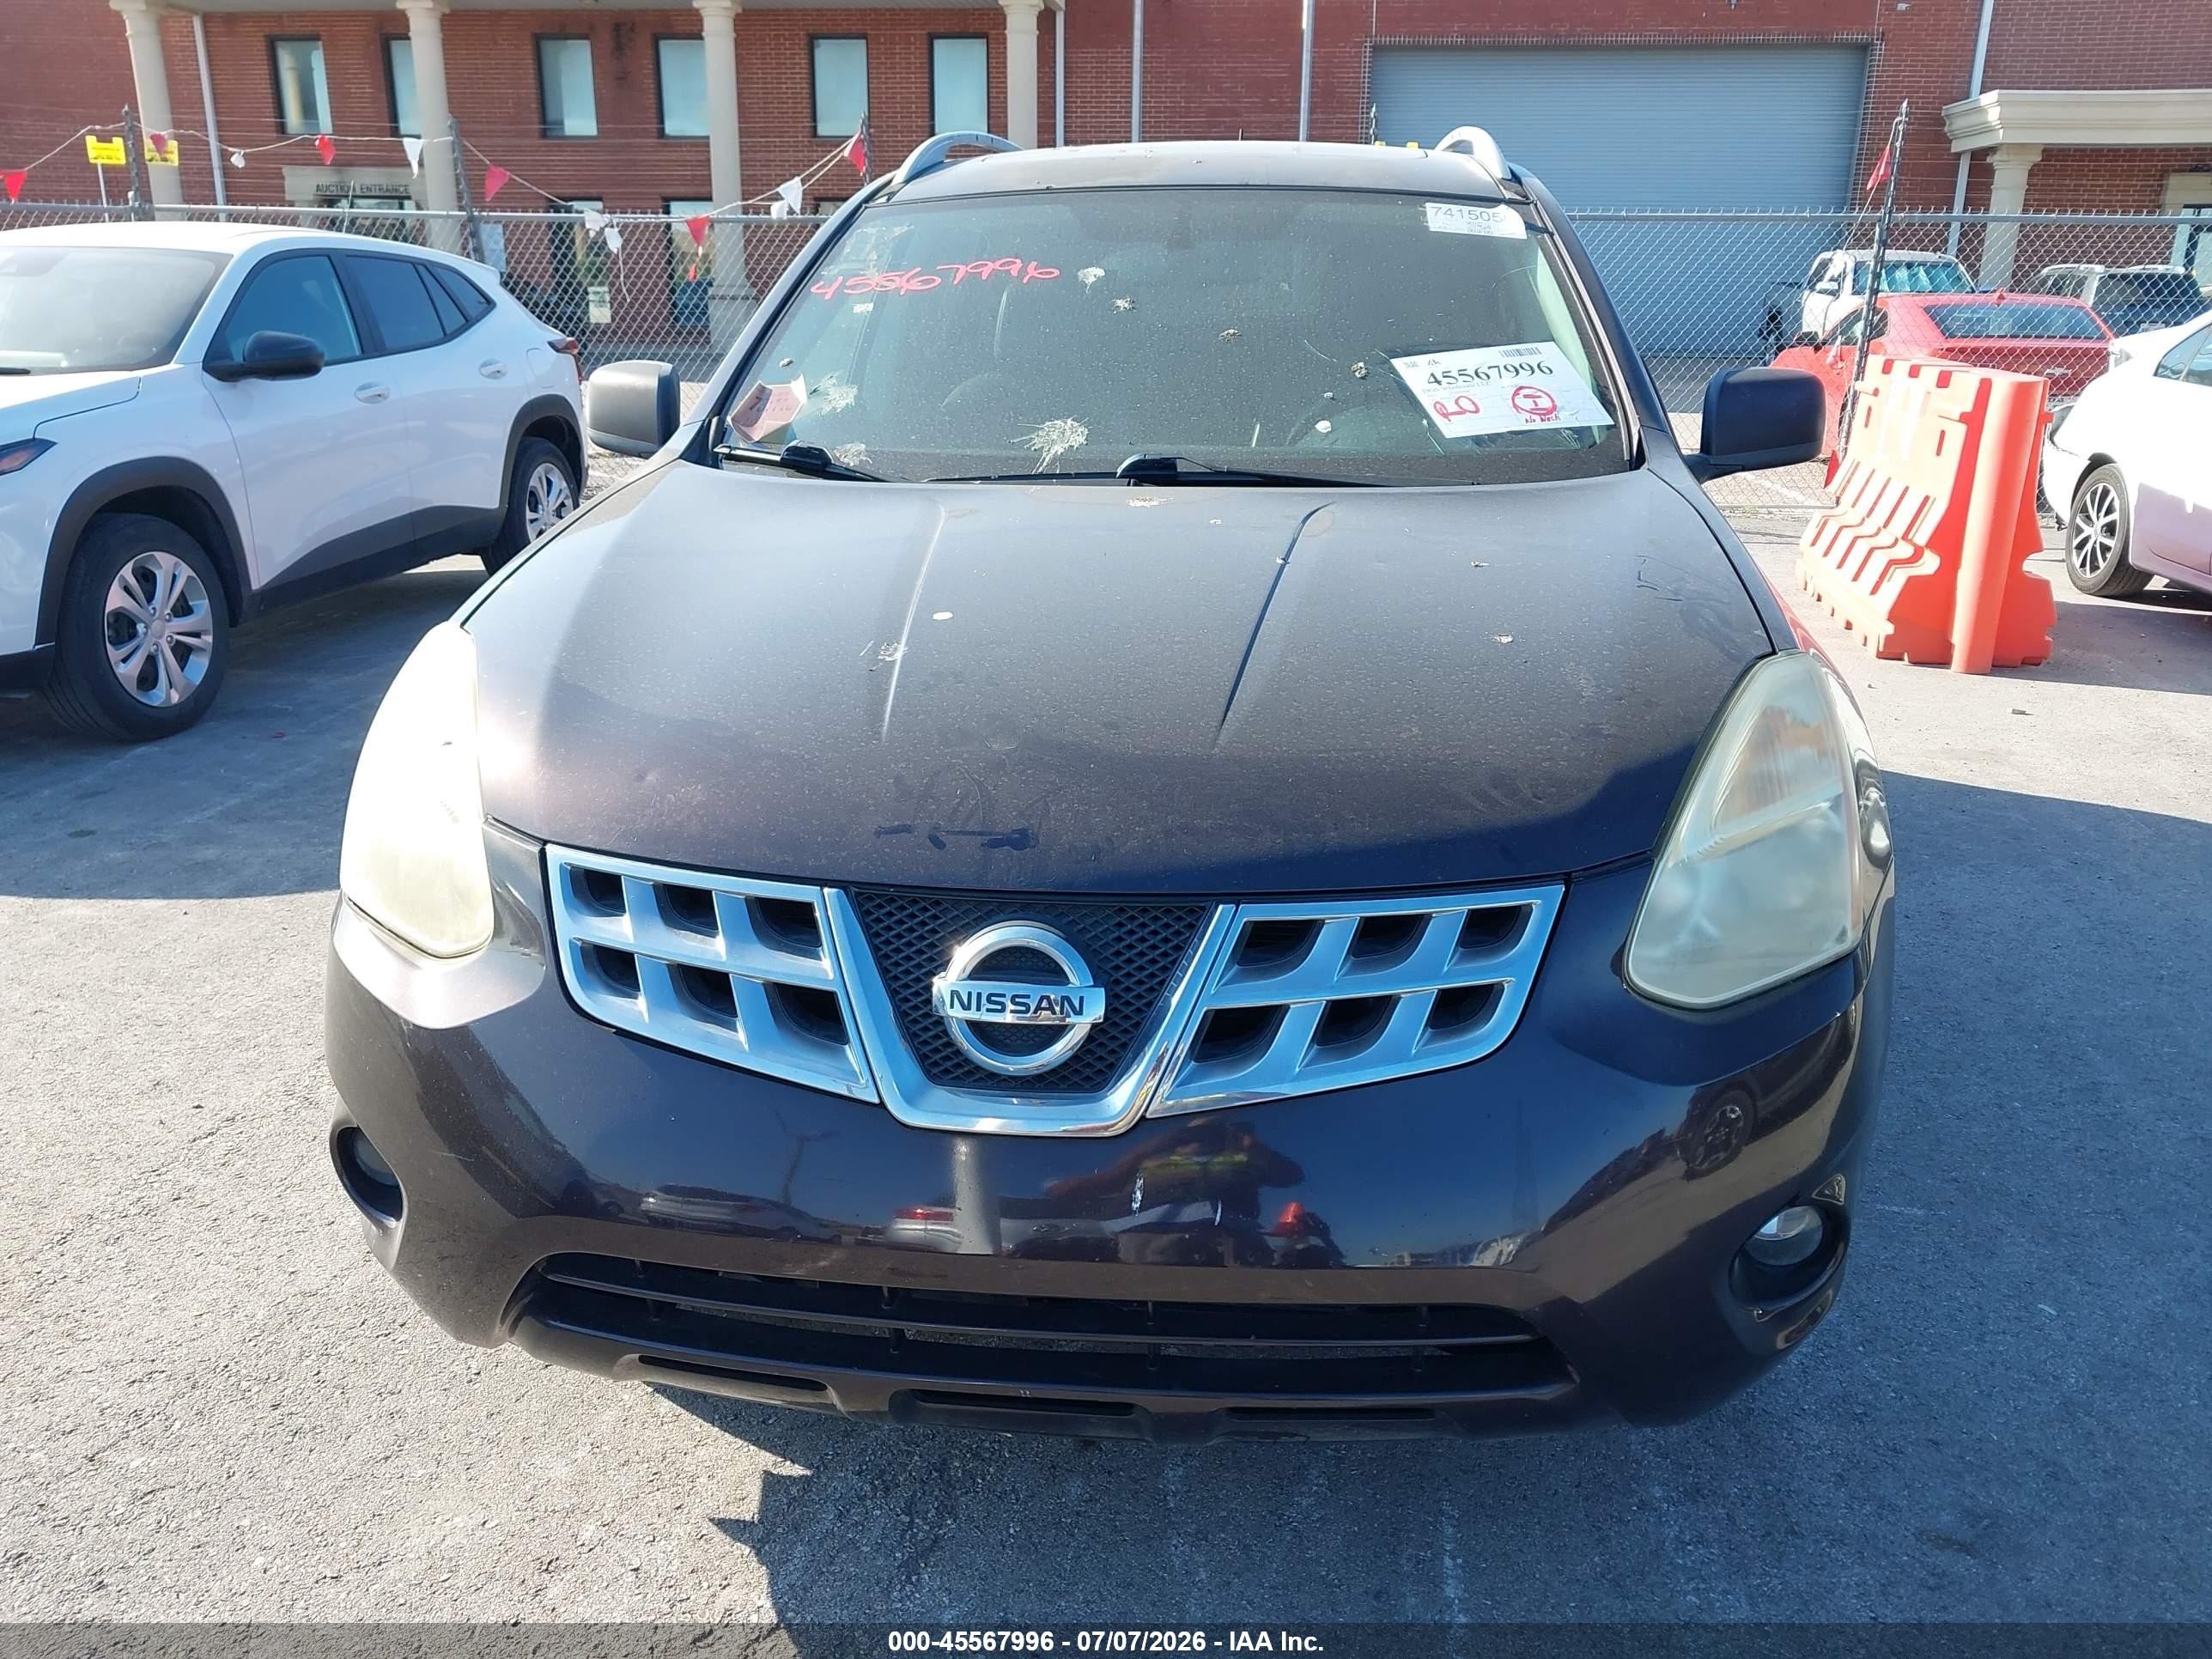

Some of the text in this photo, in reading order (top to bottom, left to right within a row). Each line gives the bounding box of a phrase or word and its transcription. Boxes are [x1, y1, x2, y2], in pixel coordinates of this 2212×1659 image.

[315, 183, 410, 195] AUCTION ENTRANCE
[810, 258, 1060, 301] 45567996
[1427, 360, 1553, 386] 45567996
[950, 989, 1084, 1016] NISSAN
